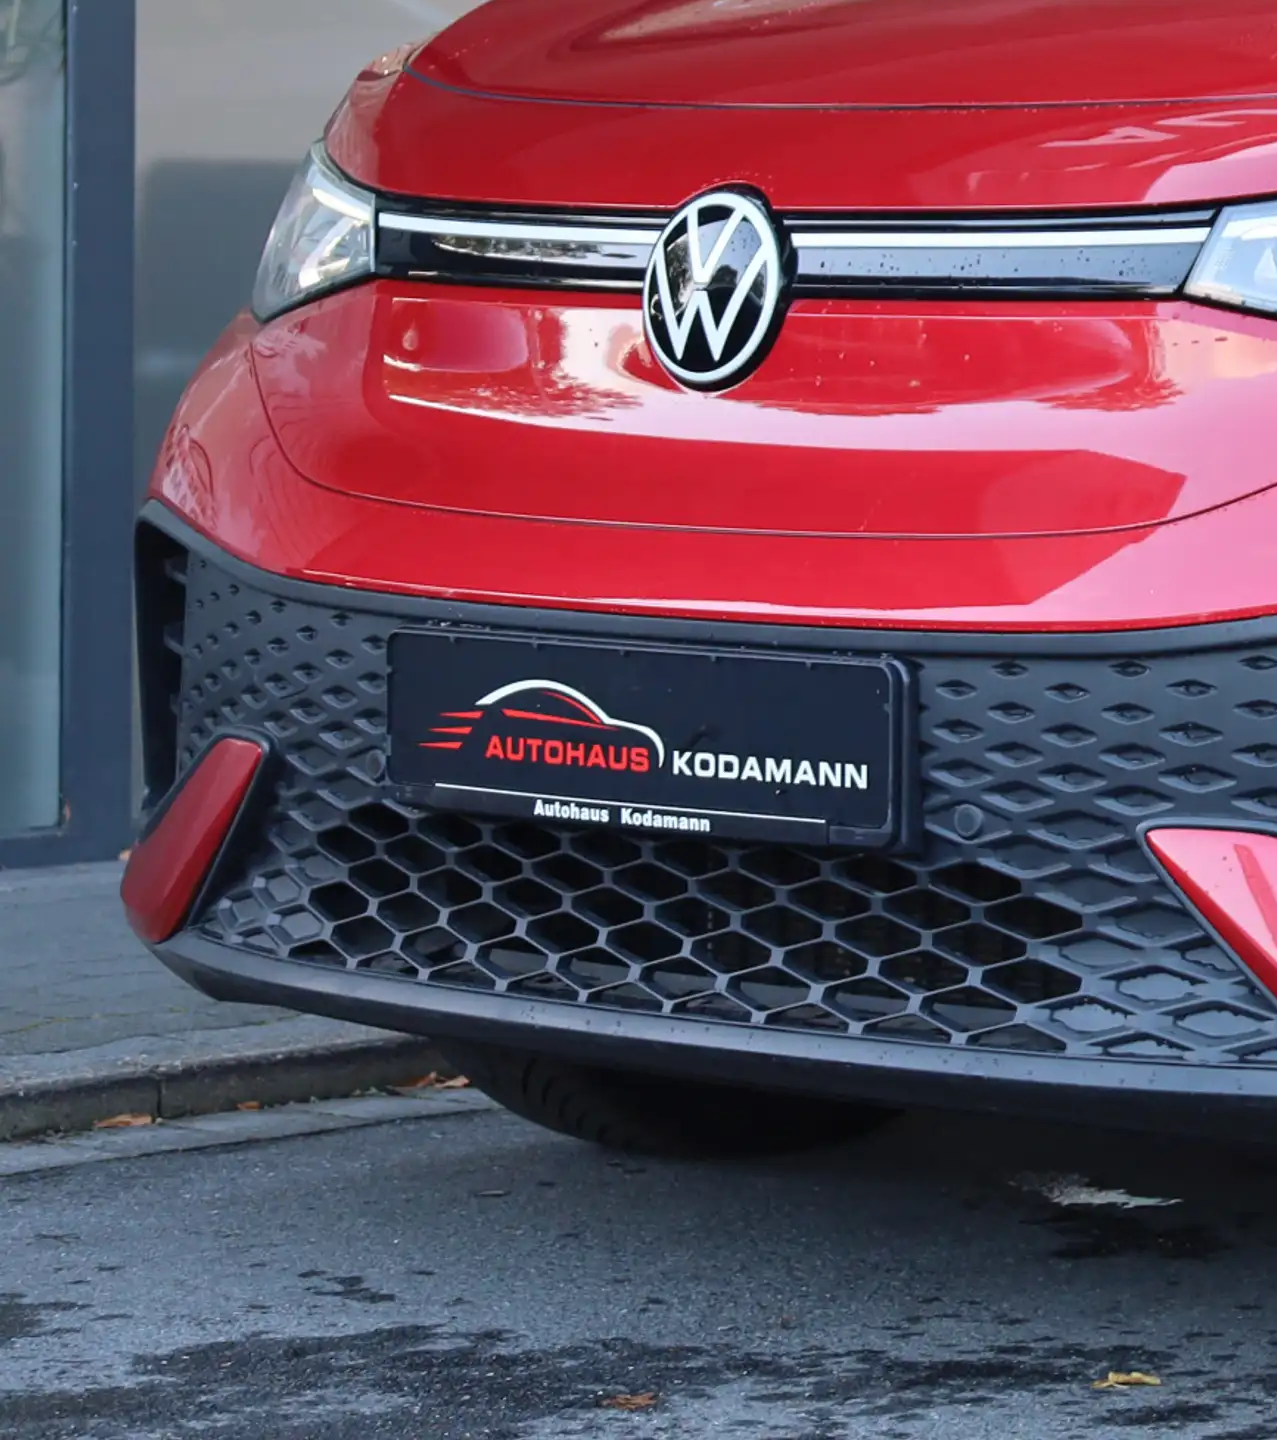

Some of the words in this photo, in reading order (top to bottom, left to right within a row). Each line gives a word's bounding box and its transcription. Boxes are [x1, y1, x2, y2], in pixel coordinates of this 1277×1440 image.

[485, 734, 650, 773] AUTOHAUS
[672, 749, 869, 790] KODAMANN
[533, 799, 610, 824] Autohaus
[620, 807, 711, 832] Kodamann
